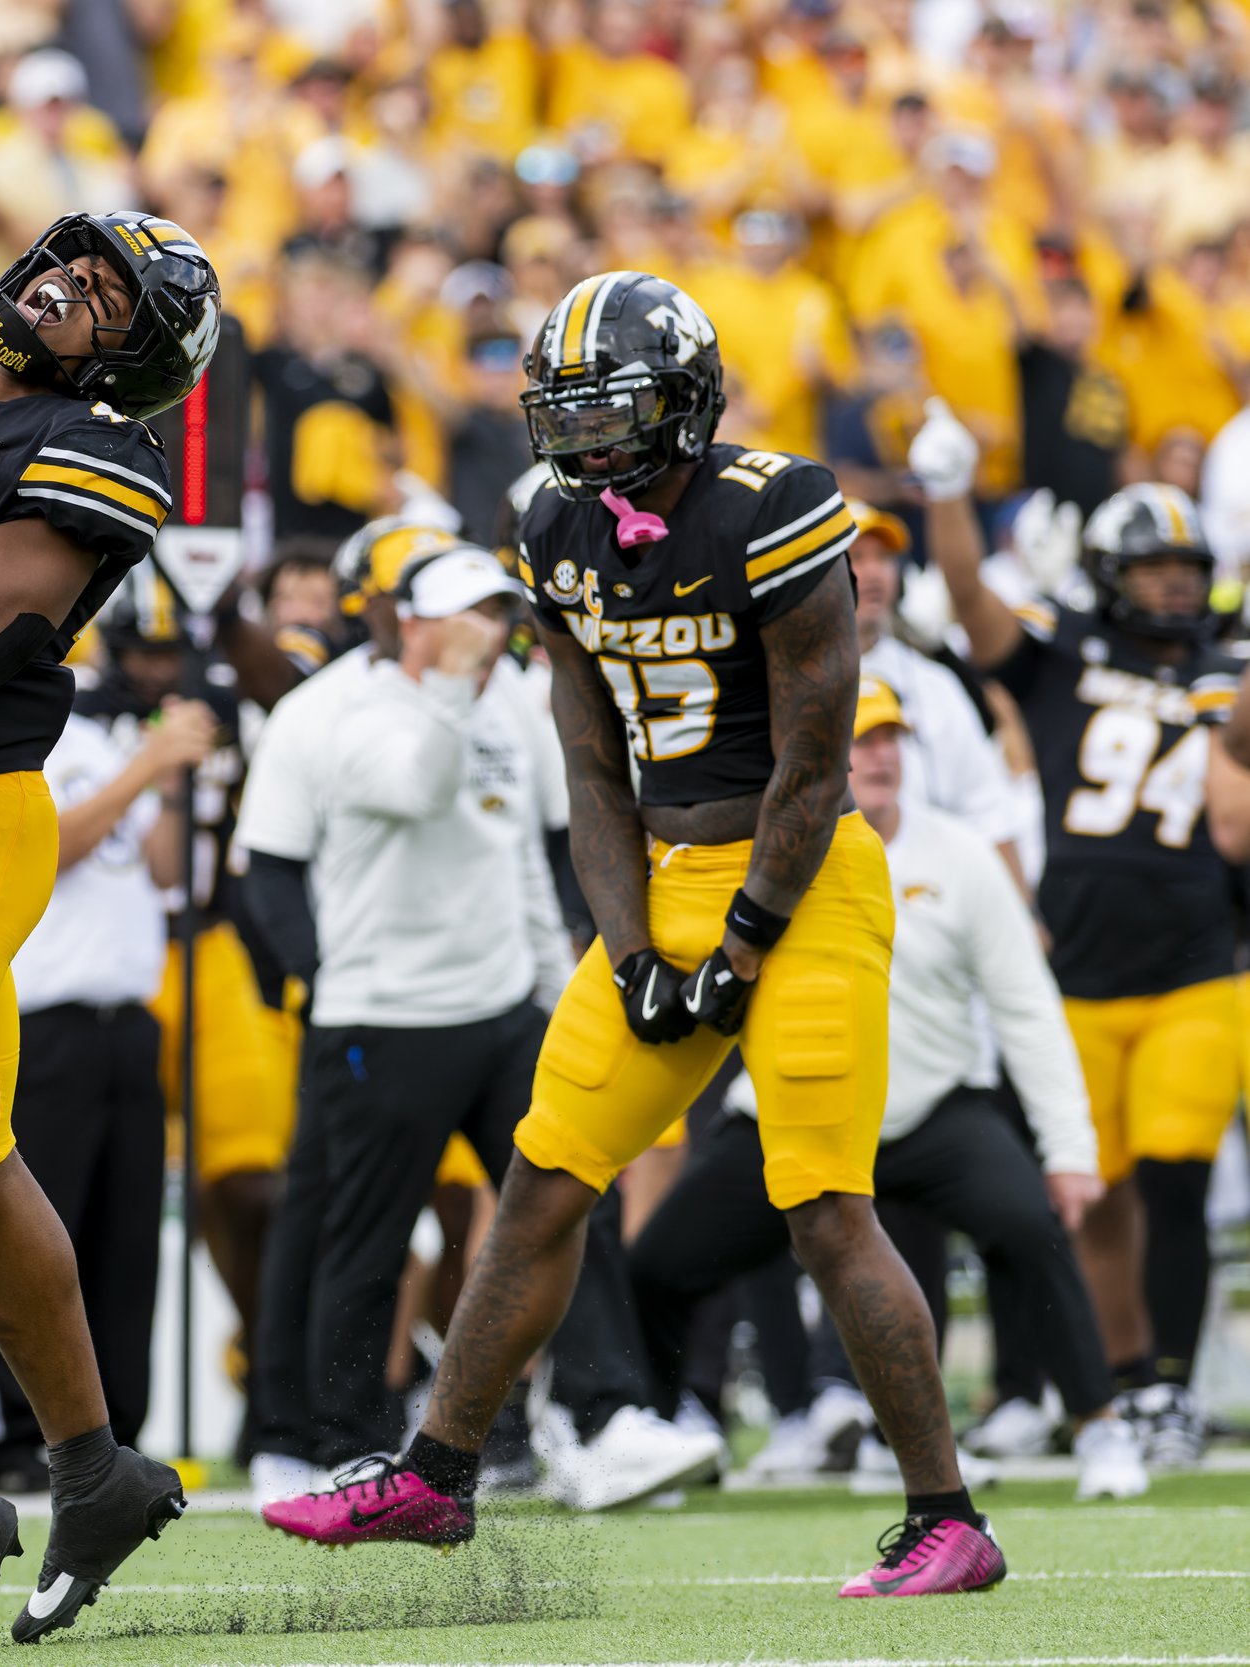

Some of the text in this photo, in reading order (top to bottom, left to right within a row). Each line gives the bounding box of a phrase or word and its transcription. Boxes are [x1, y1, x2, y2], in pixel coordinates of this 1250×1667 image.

[114, 225, 144, 256] MIZZOU
[645, 290, 716, 366] M
[718, 451, 792, 493] 13
[583, 567, 603, 619] C
[598, 655, 720, 762] 13
[1062, 704, 1211, 849] 94
